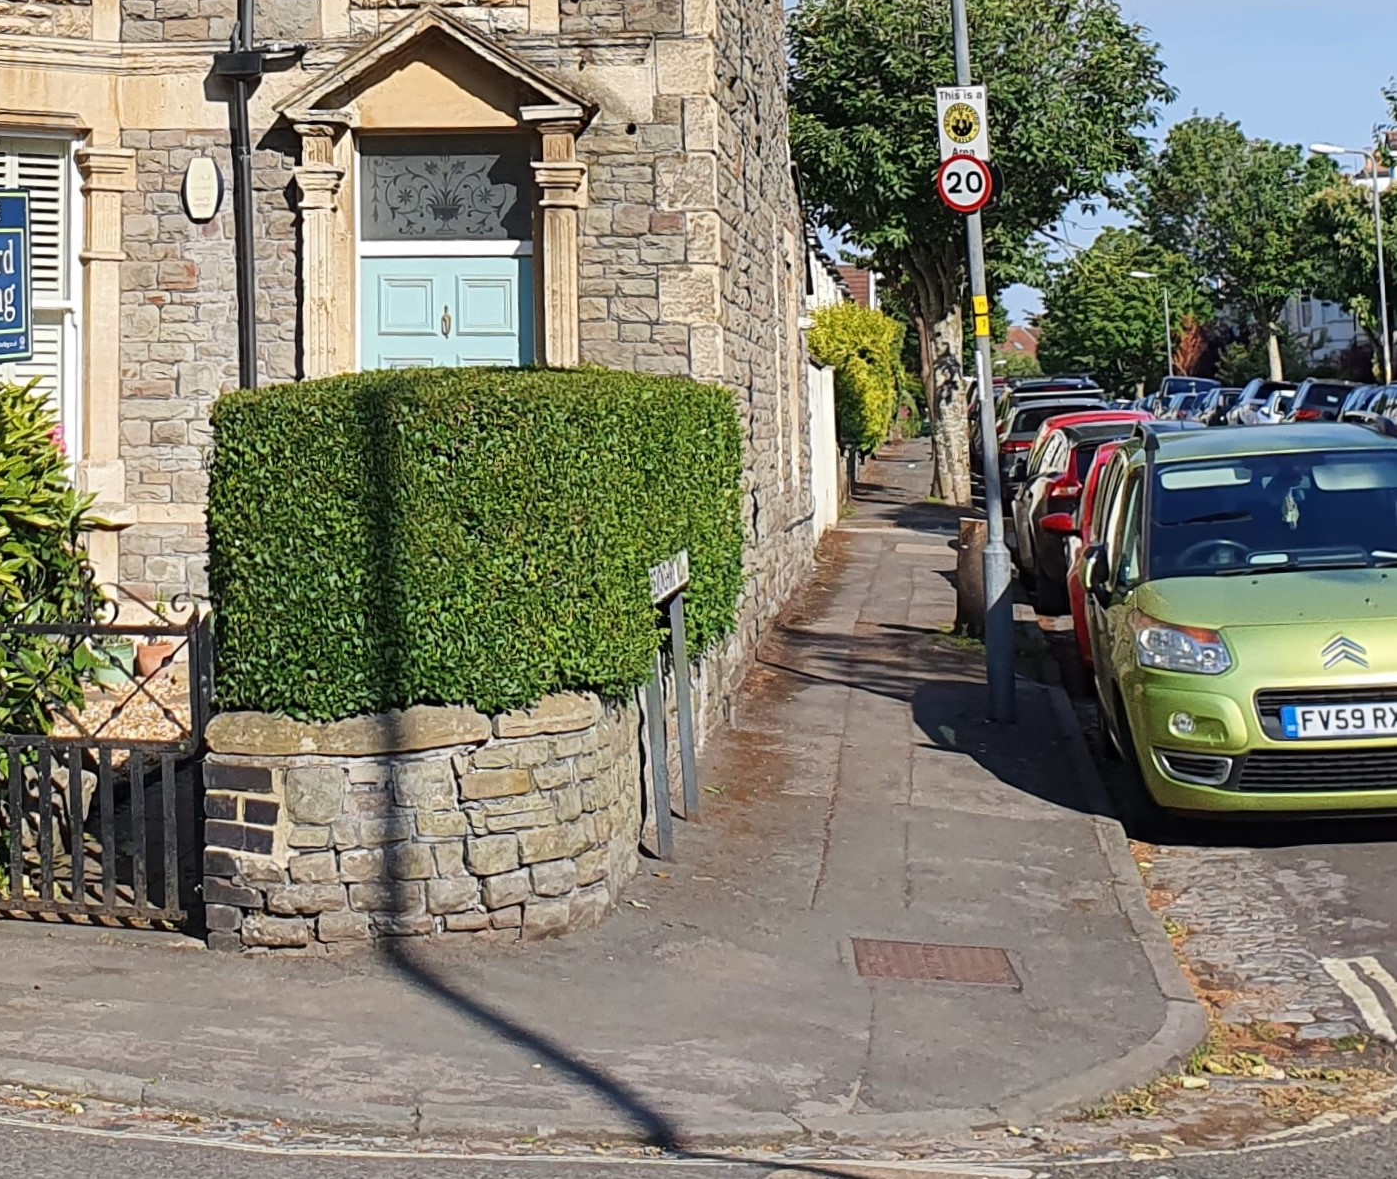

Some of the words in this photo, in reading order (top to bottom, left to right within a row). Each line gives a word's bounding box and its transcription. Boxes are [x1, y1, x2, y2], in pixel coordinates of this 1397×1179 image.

[939, 91, 960, 101] This
[963, 91, 973, 100] is
[976, 91, 983, 100] a
[946, 171, 983, 194] 20
[1301, 708, 1365, 731] FV59
